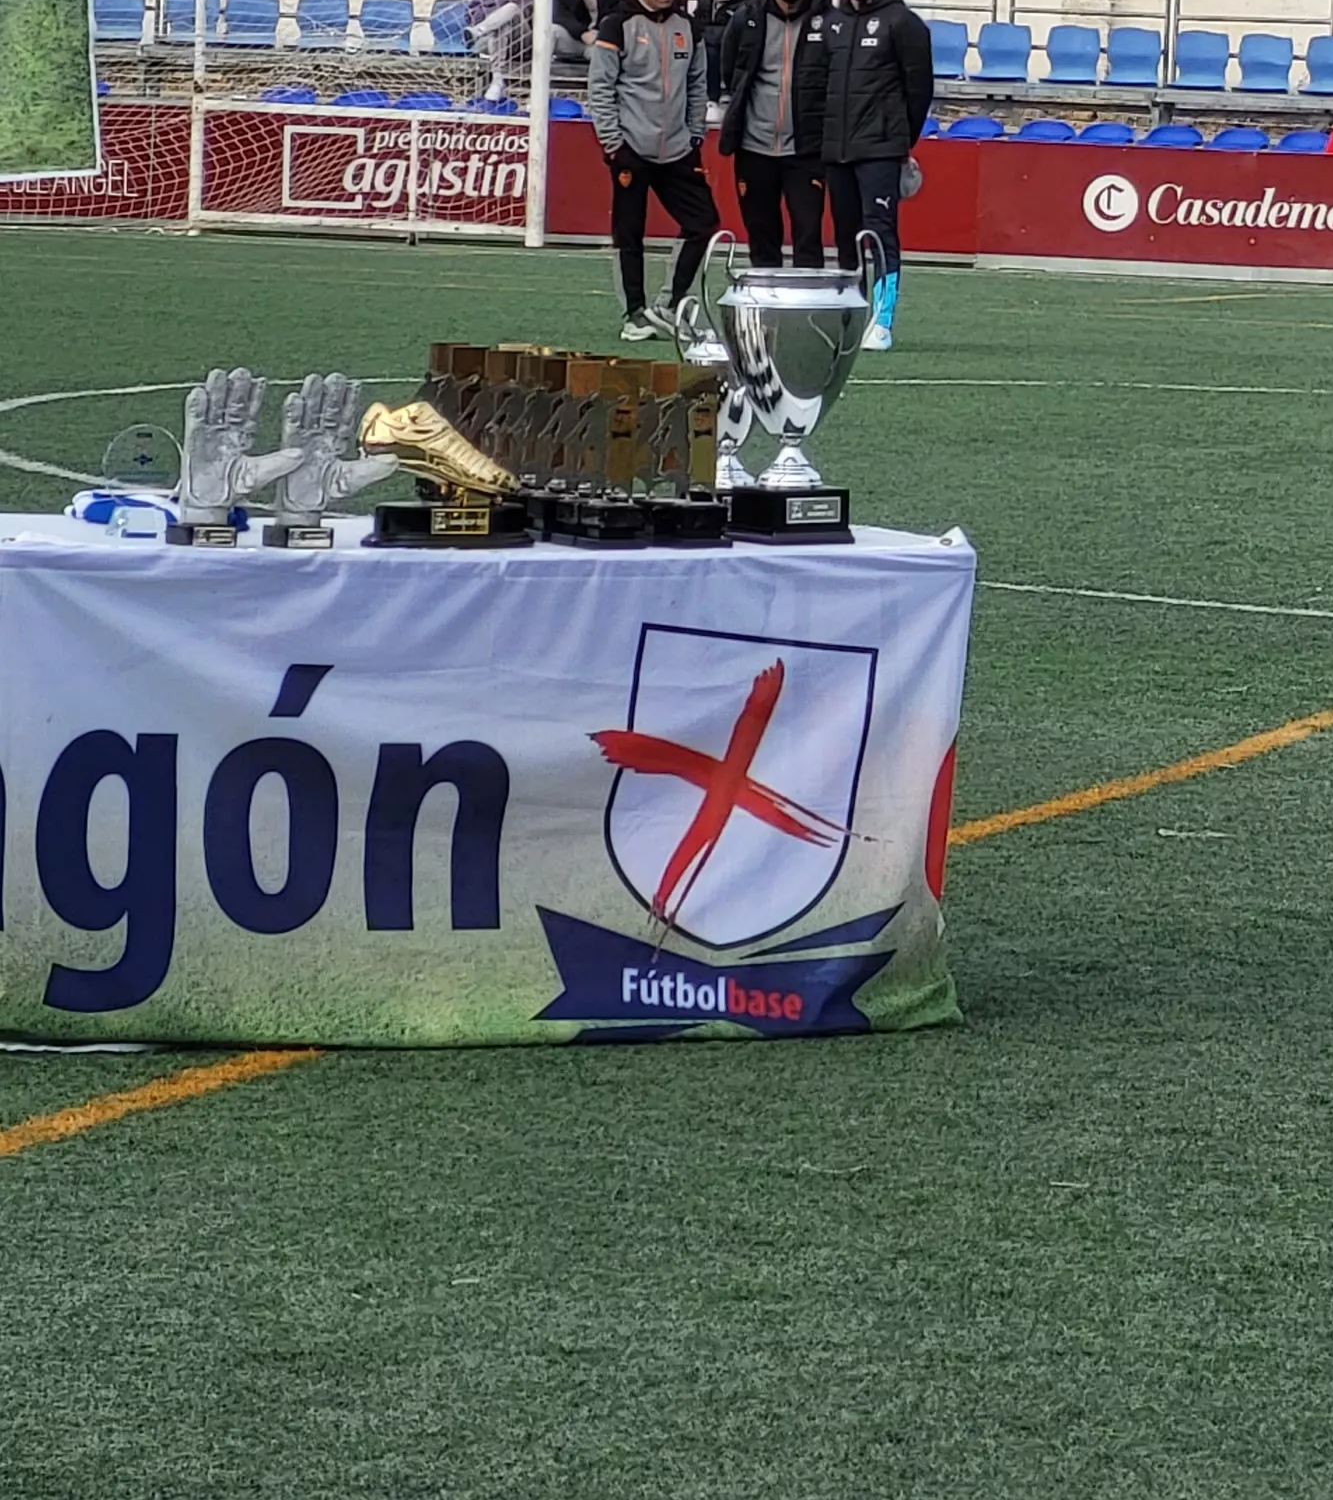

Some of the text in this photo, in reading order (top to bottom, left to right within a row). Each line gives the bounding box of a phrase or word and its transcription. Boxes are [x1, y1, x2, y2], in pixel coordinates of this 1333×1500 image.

[373, 129, 530, 154] preabricados
[0, 664, 510, 1013] gón
[622, 967, 803, 1021] Fútbolbase
